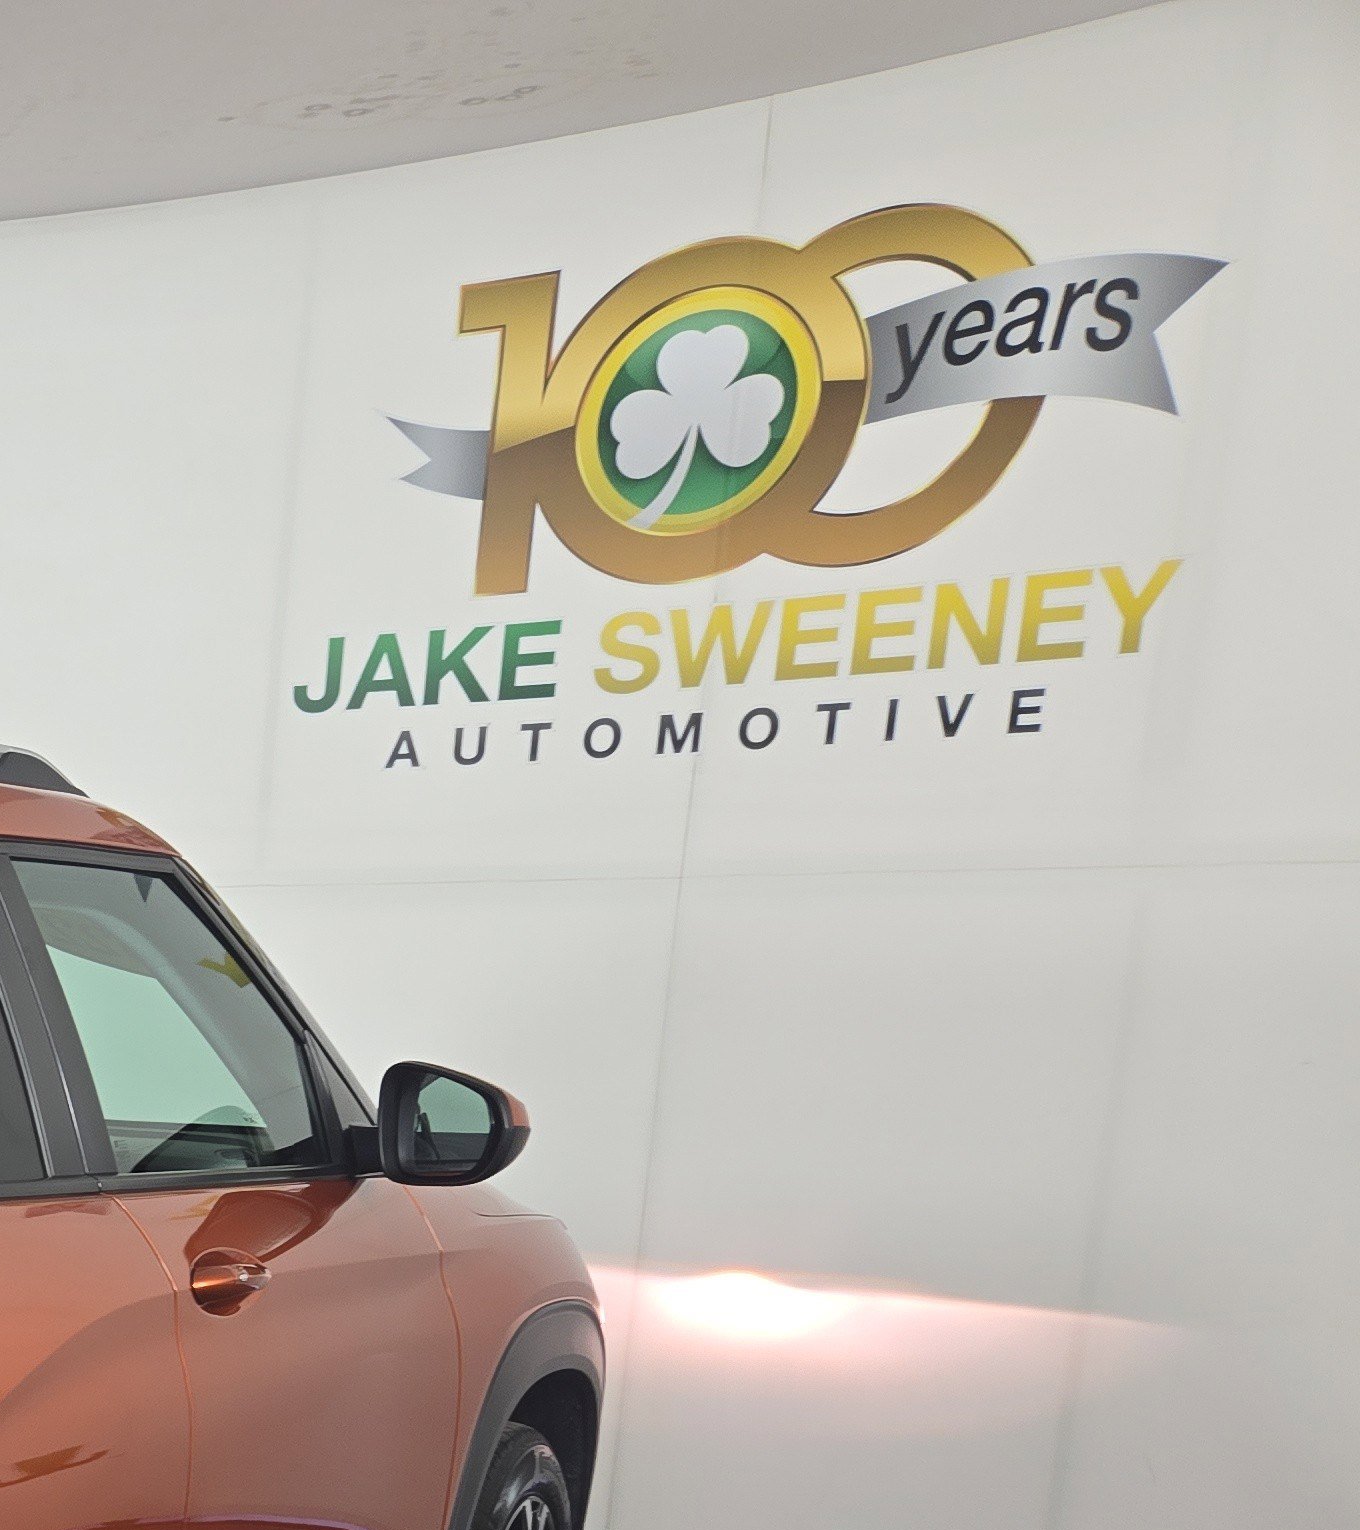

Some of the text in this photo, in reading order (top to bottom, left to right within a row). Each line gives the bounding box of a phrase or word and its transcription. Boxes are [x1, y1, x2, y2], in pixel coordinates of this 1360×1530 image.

[884, 272, 1140, 403] years
[293, 558, 1184, 714] JAKE SWEENEY
[385, 688, 1048, 770] AUTOMOTIVE
